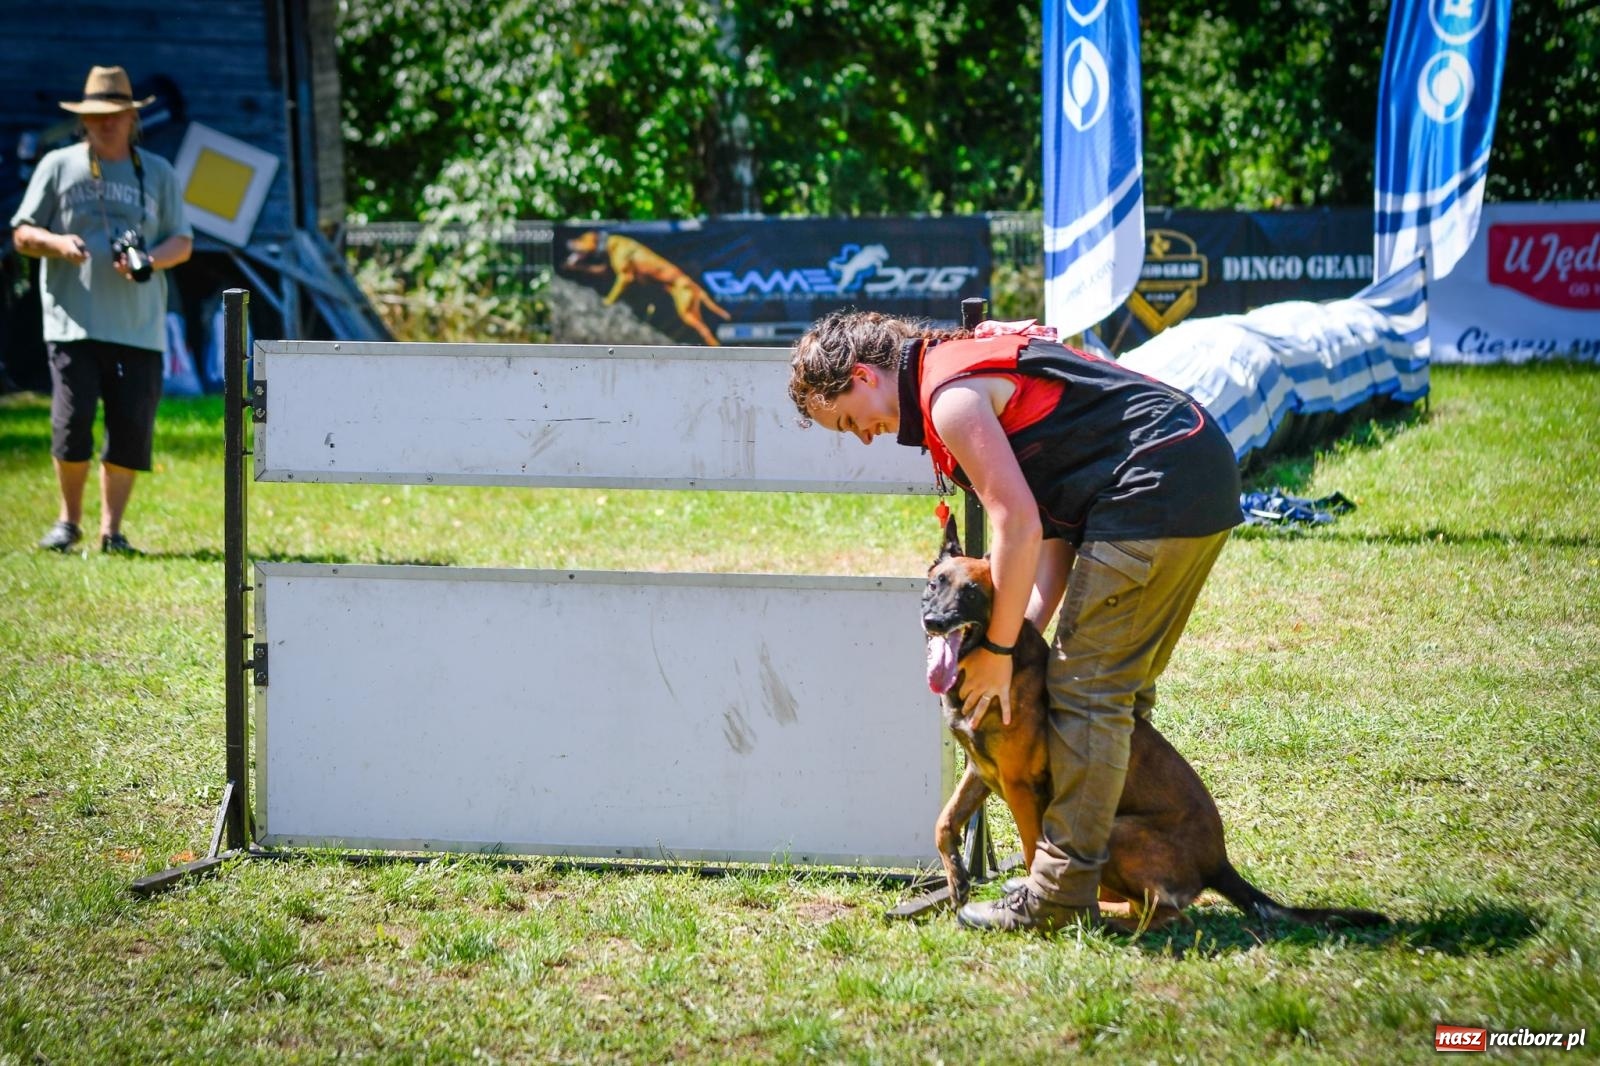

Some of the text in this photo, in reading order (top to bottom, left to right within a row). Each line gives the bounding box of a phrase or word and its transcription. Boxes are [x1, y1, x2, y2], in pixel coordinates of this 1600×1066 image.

[60, 180, 158, 213] WASHINGT
[1222, 254, 1374, 281] DINGO GEAR
[1532, 232, 1600, 284] Jęd
[703, 266, 971, 294] GAME DOG
